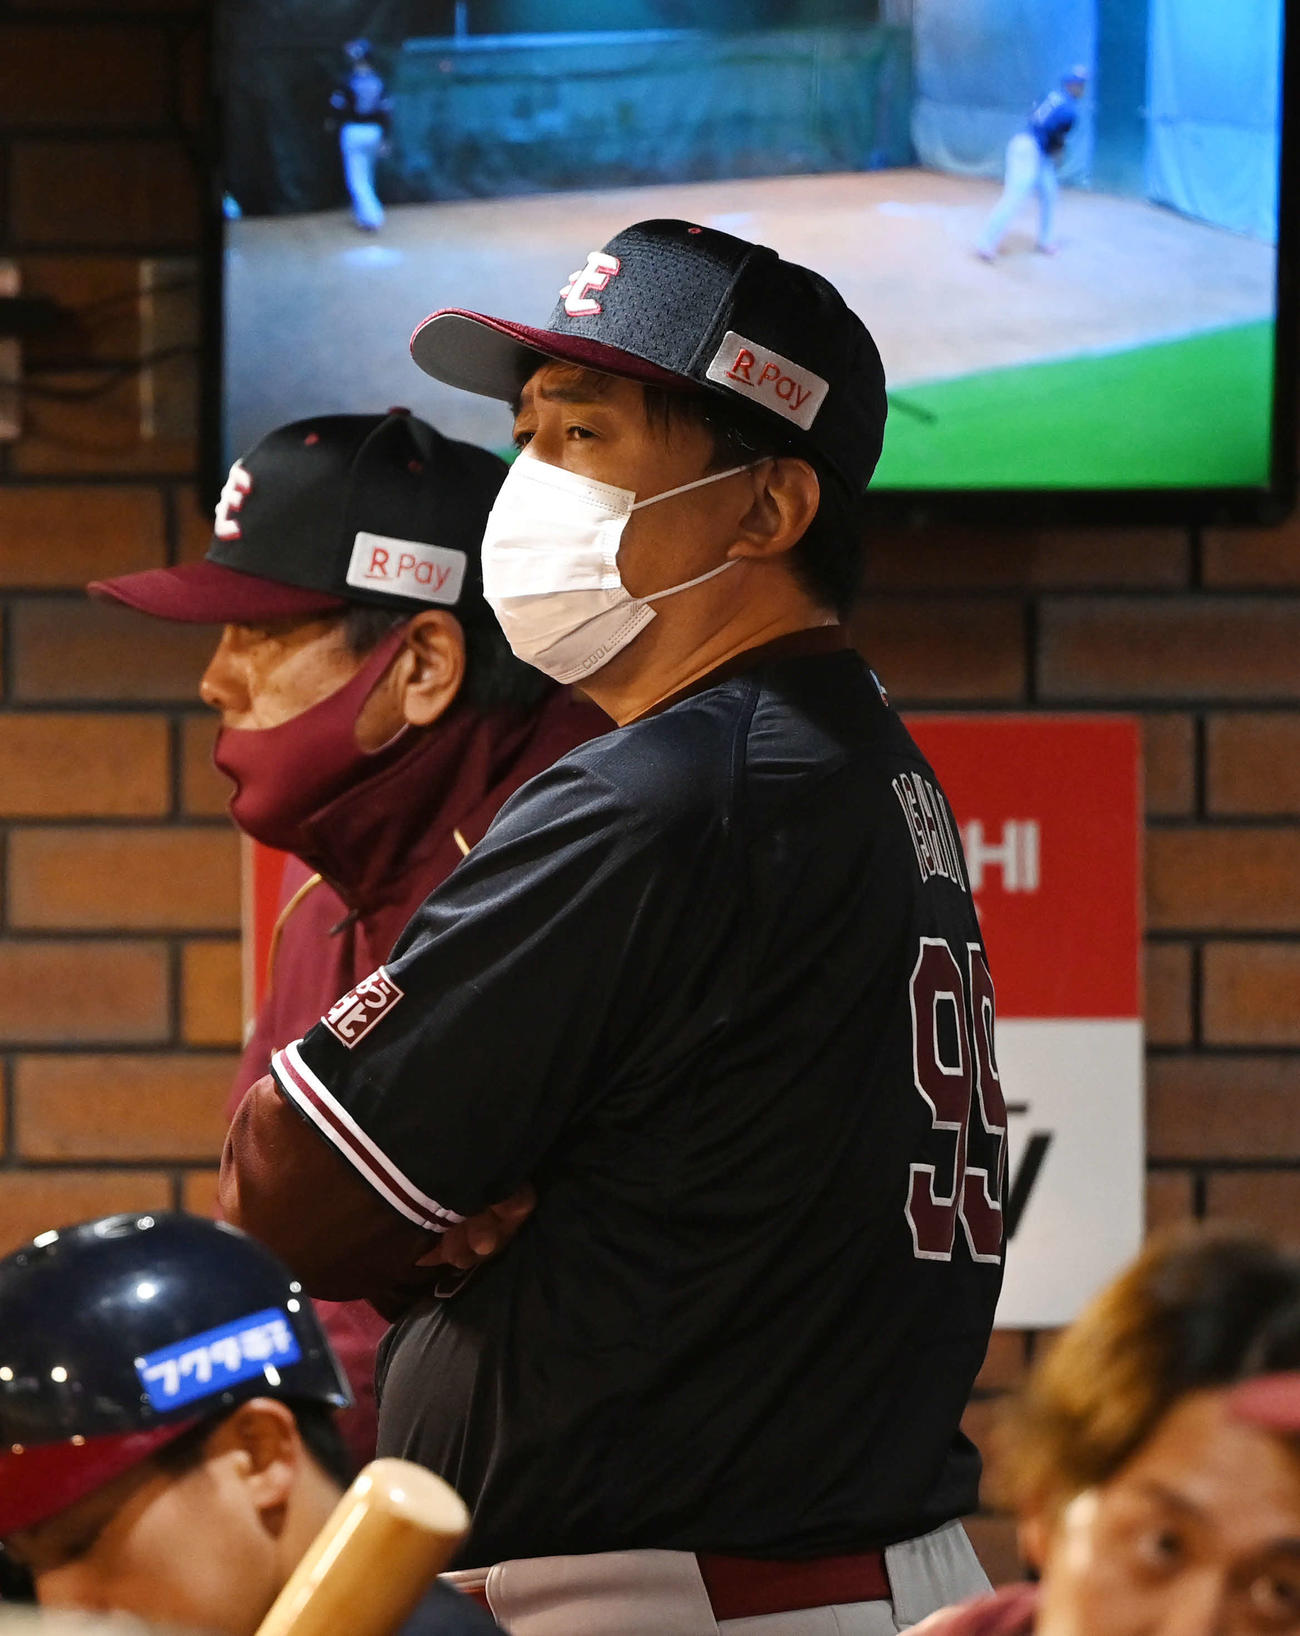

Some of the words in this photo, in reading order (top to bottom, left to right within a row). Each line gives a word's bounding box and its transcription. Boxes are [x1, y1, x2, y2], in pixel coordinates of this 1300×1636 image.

[559, 250, 621, 317] E
[724, 347, 756, 388] R
[757, 361, 812, 411] Pay
[212, 456, 253, 542] E
[365, 546, 392, 582] R
[397, 552, 451, 592] Pay
[582, 643, 612, 670] COOL
[957, 818, 1040, 894] HI
[903, 936, 1009, 1265] 99
